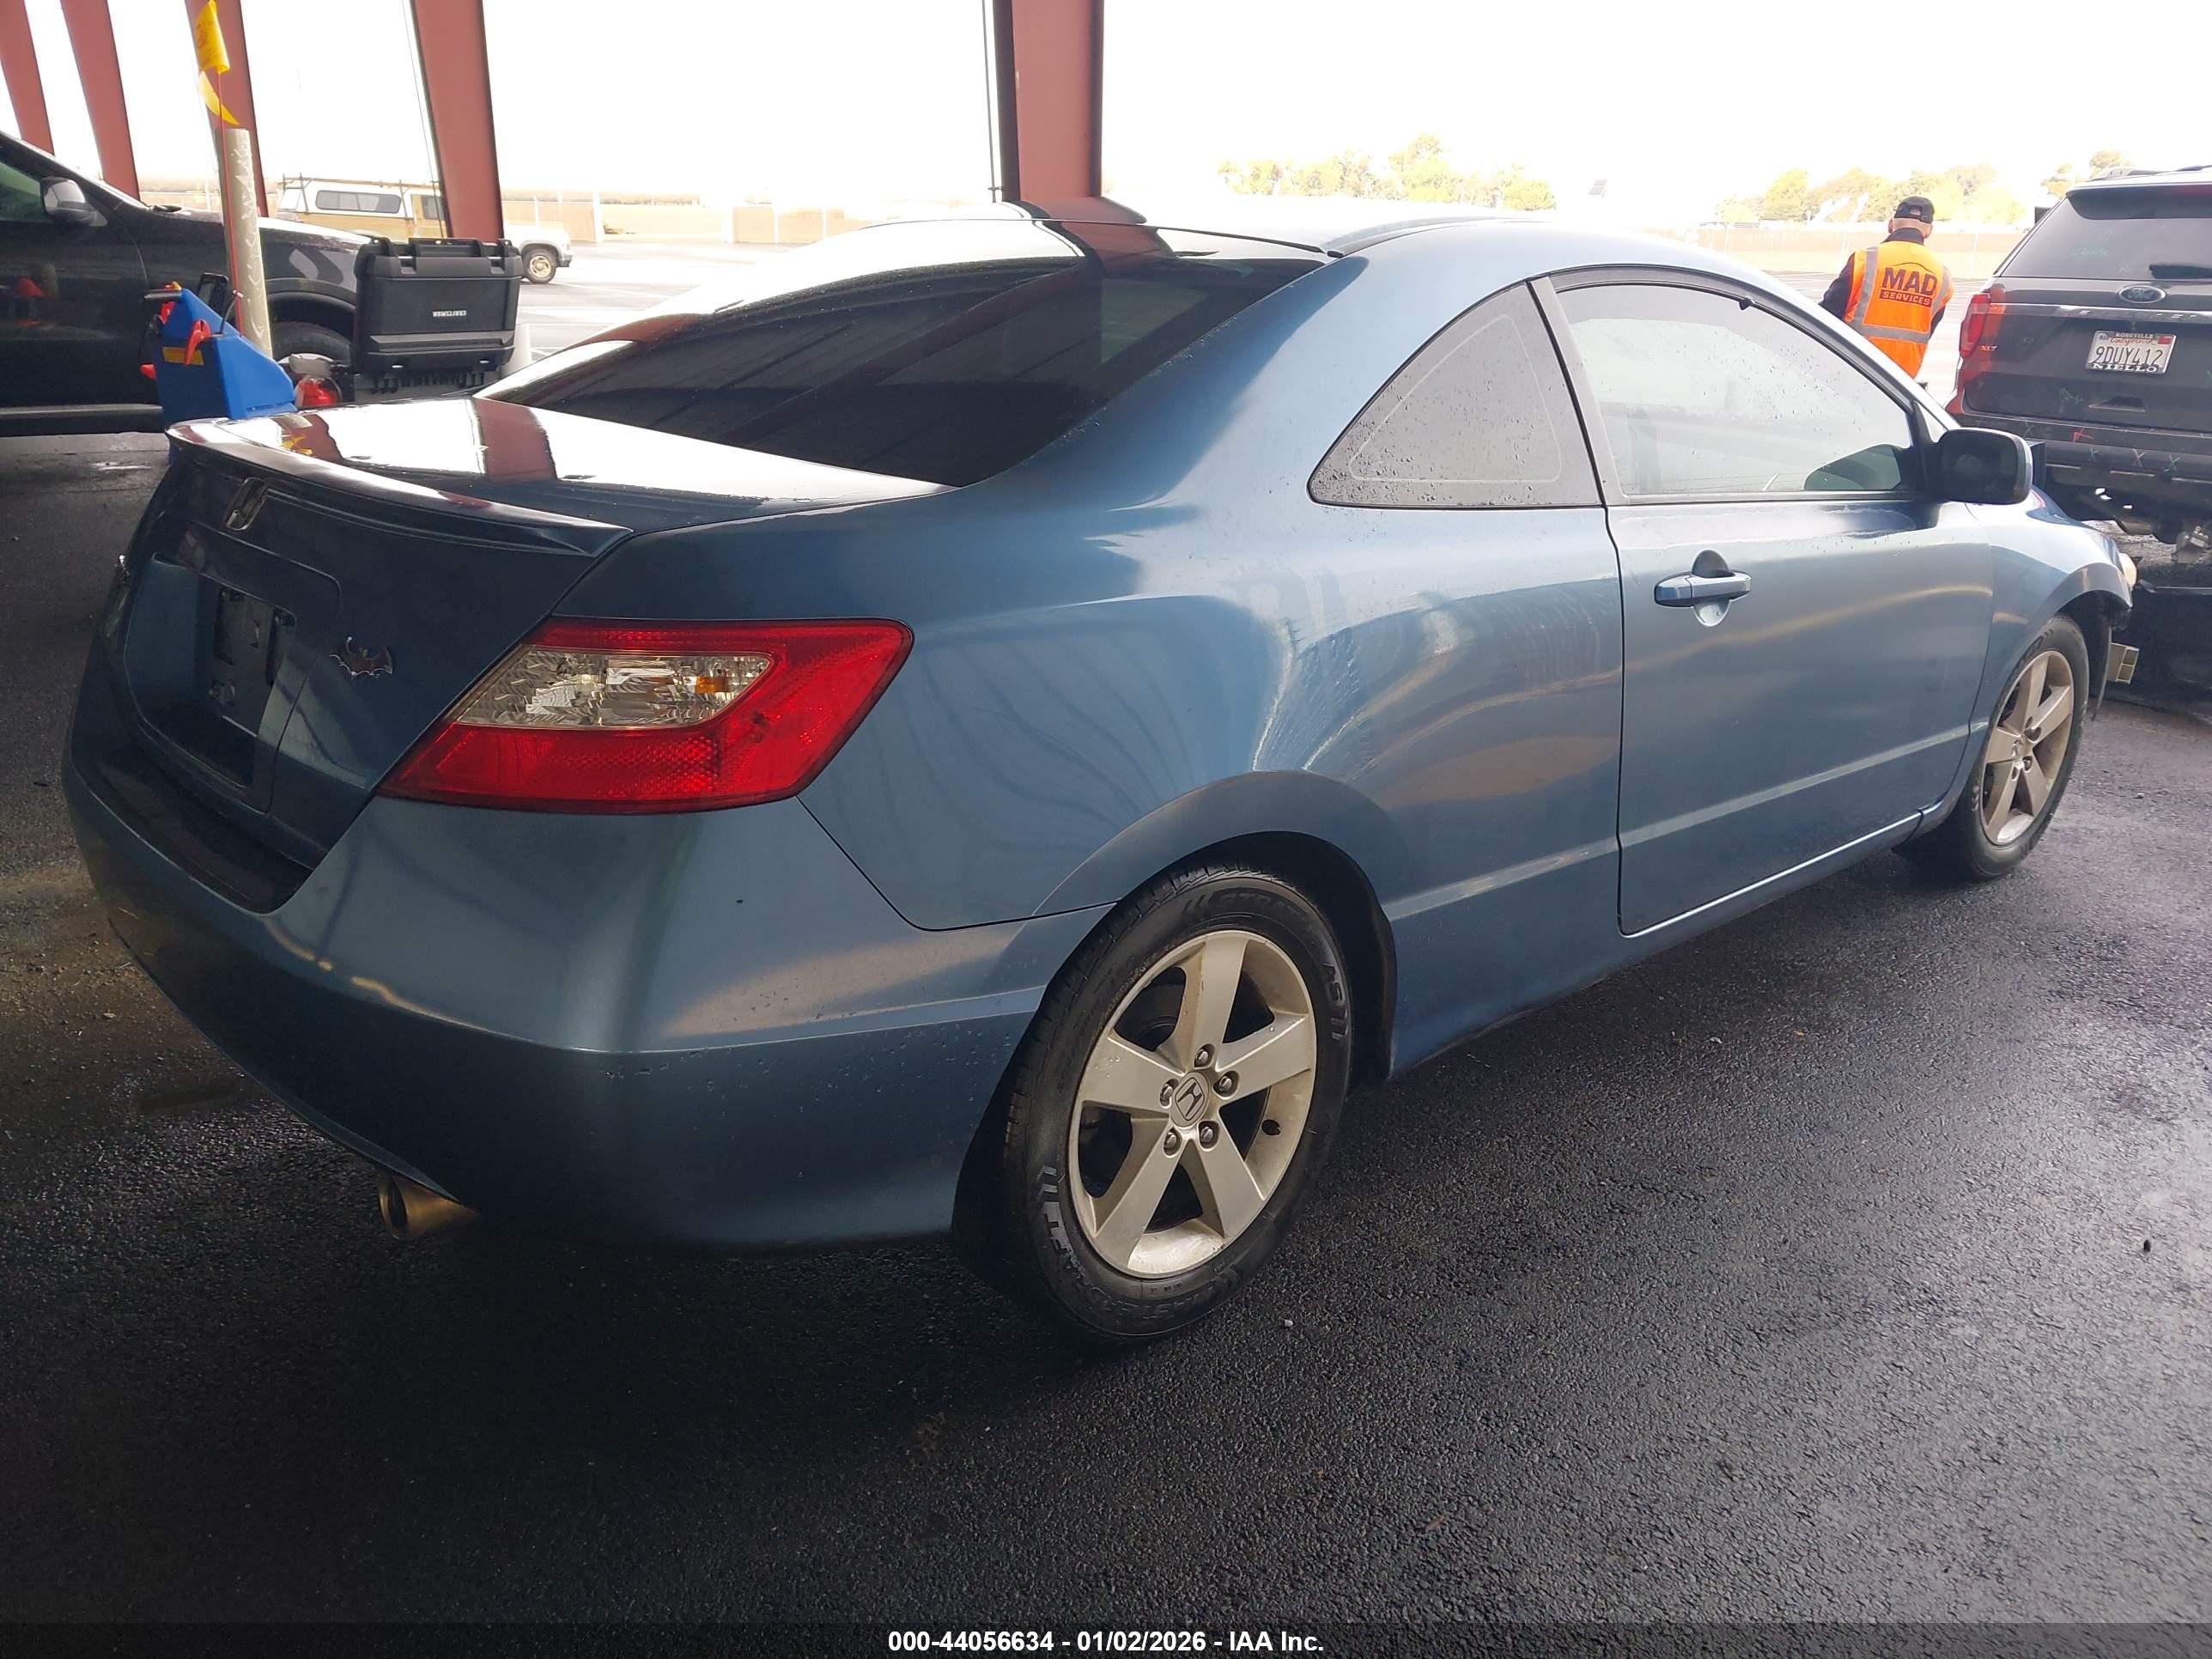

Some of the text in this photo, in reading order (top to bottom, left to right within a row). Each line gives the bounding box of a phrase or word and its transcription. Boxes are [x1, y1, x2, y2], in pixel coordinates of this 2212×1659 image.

[1881, 267, 1937, 296] MAD
[1881, 291, 1931, 307] SERVICES
[2092, 346, 2163, 366] 9DUY412
[2092, 362, 2158, 373] NIELLO
